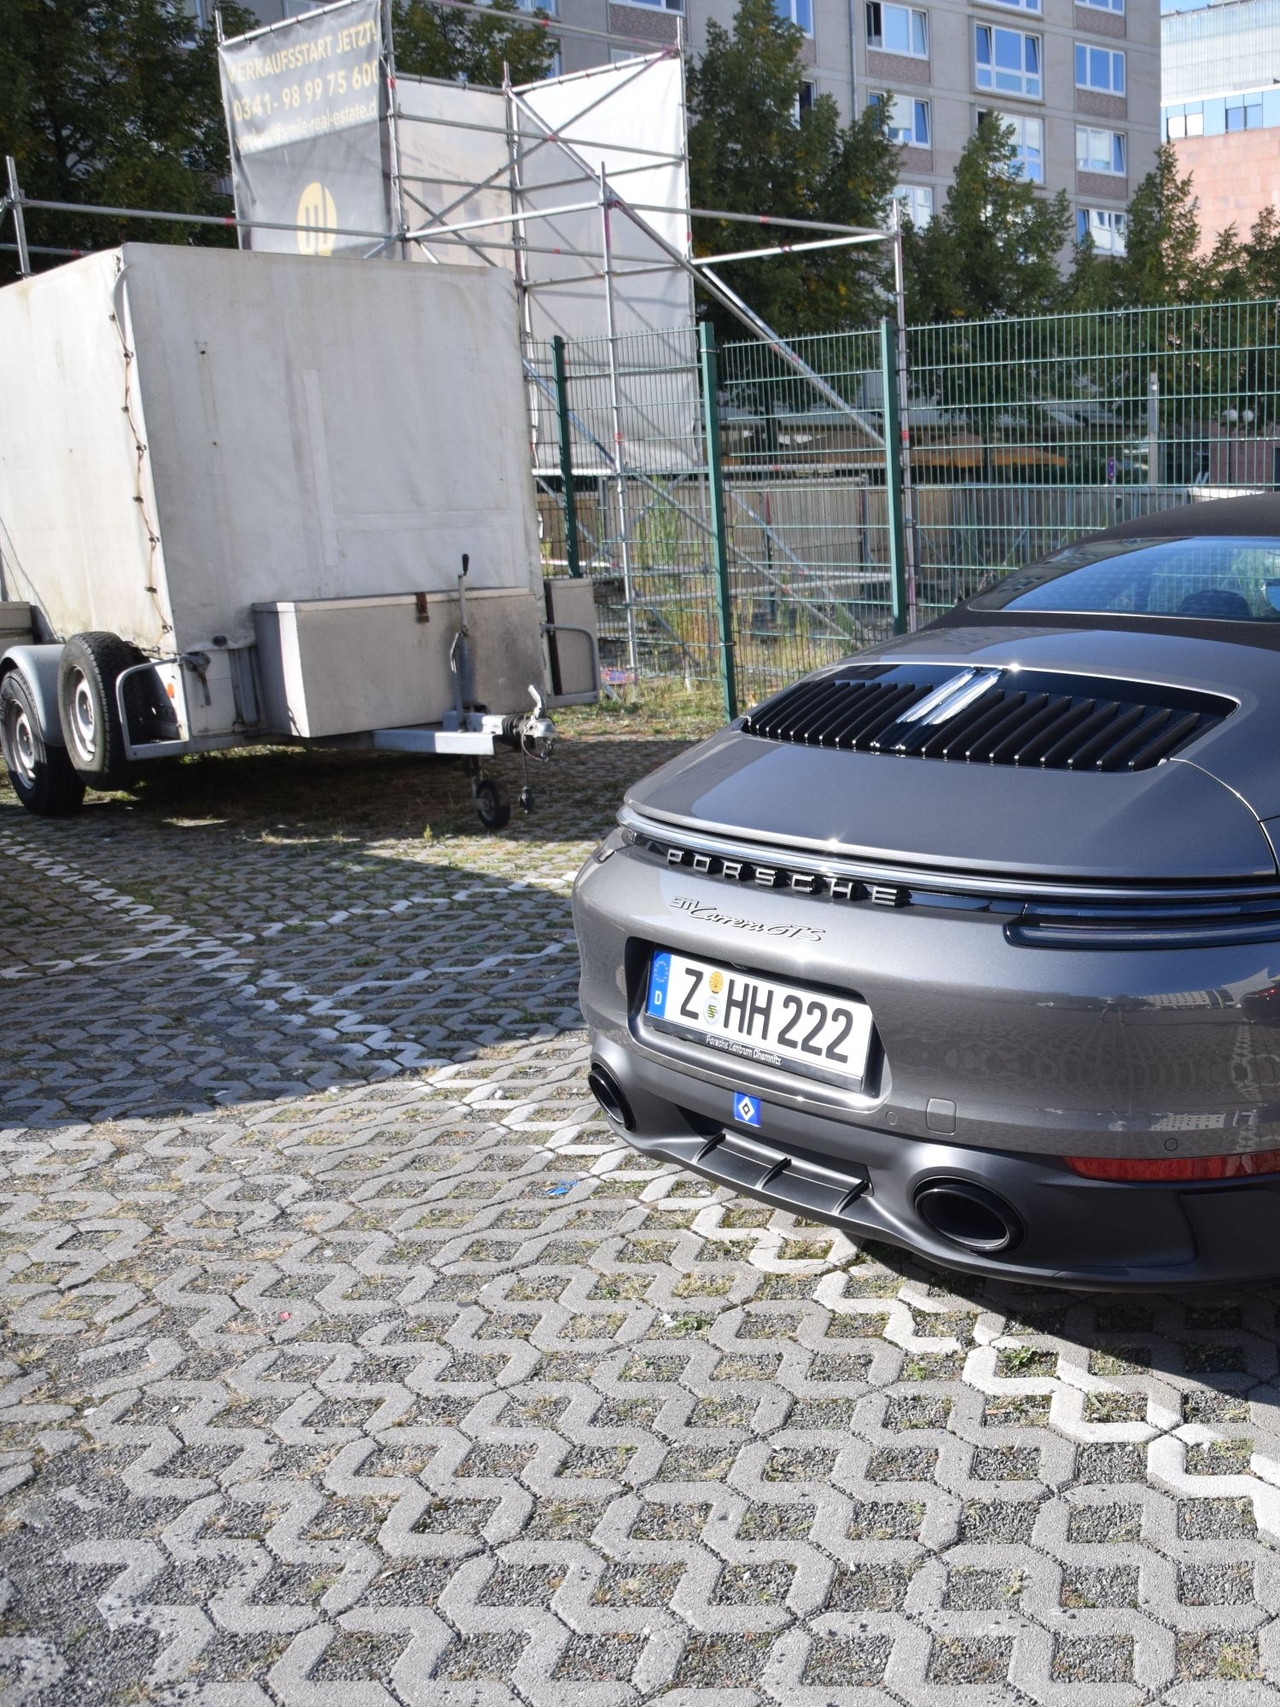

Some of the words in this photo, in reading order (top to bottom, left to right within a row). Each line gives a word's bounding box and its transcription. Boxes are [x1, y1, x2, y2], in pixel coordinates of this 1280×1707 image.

[228, 35, 333, 83] VERKAUFSSTART
[337, 20, 378, 54] JETZT!
[282, 85, 300, 110] 98
[304, 78, 322, 104] 99
[327, 70, 346, 97] 75
[667, 848, 899, 907] PORSCHE
[689, 905, 765, 933] Carrera
[766, 924, 826, 942] GTS
[654, 990, 662, 1005] D
[680, 967, 704, 1020] Z
[723, 979, 774, 1041] HH
[777, 994, 854, 1064] 222
[706, 1035, 728, 1049] Porsche
[729, 1042, 752, 1057] Zentrum
[753, 1048, 782, 1065] Chemnitz
